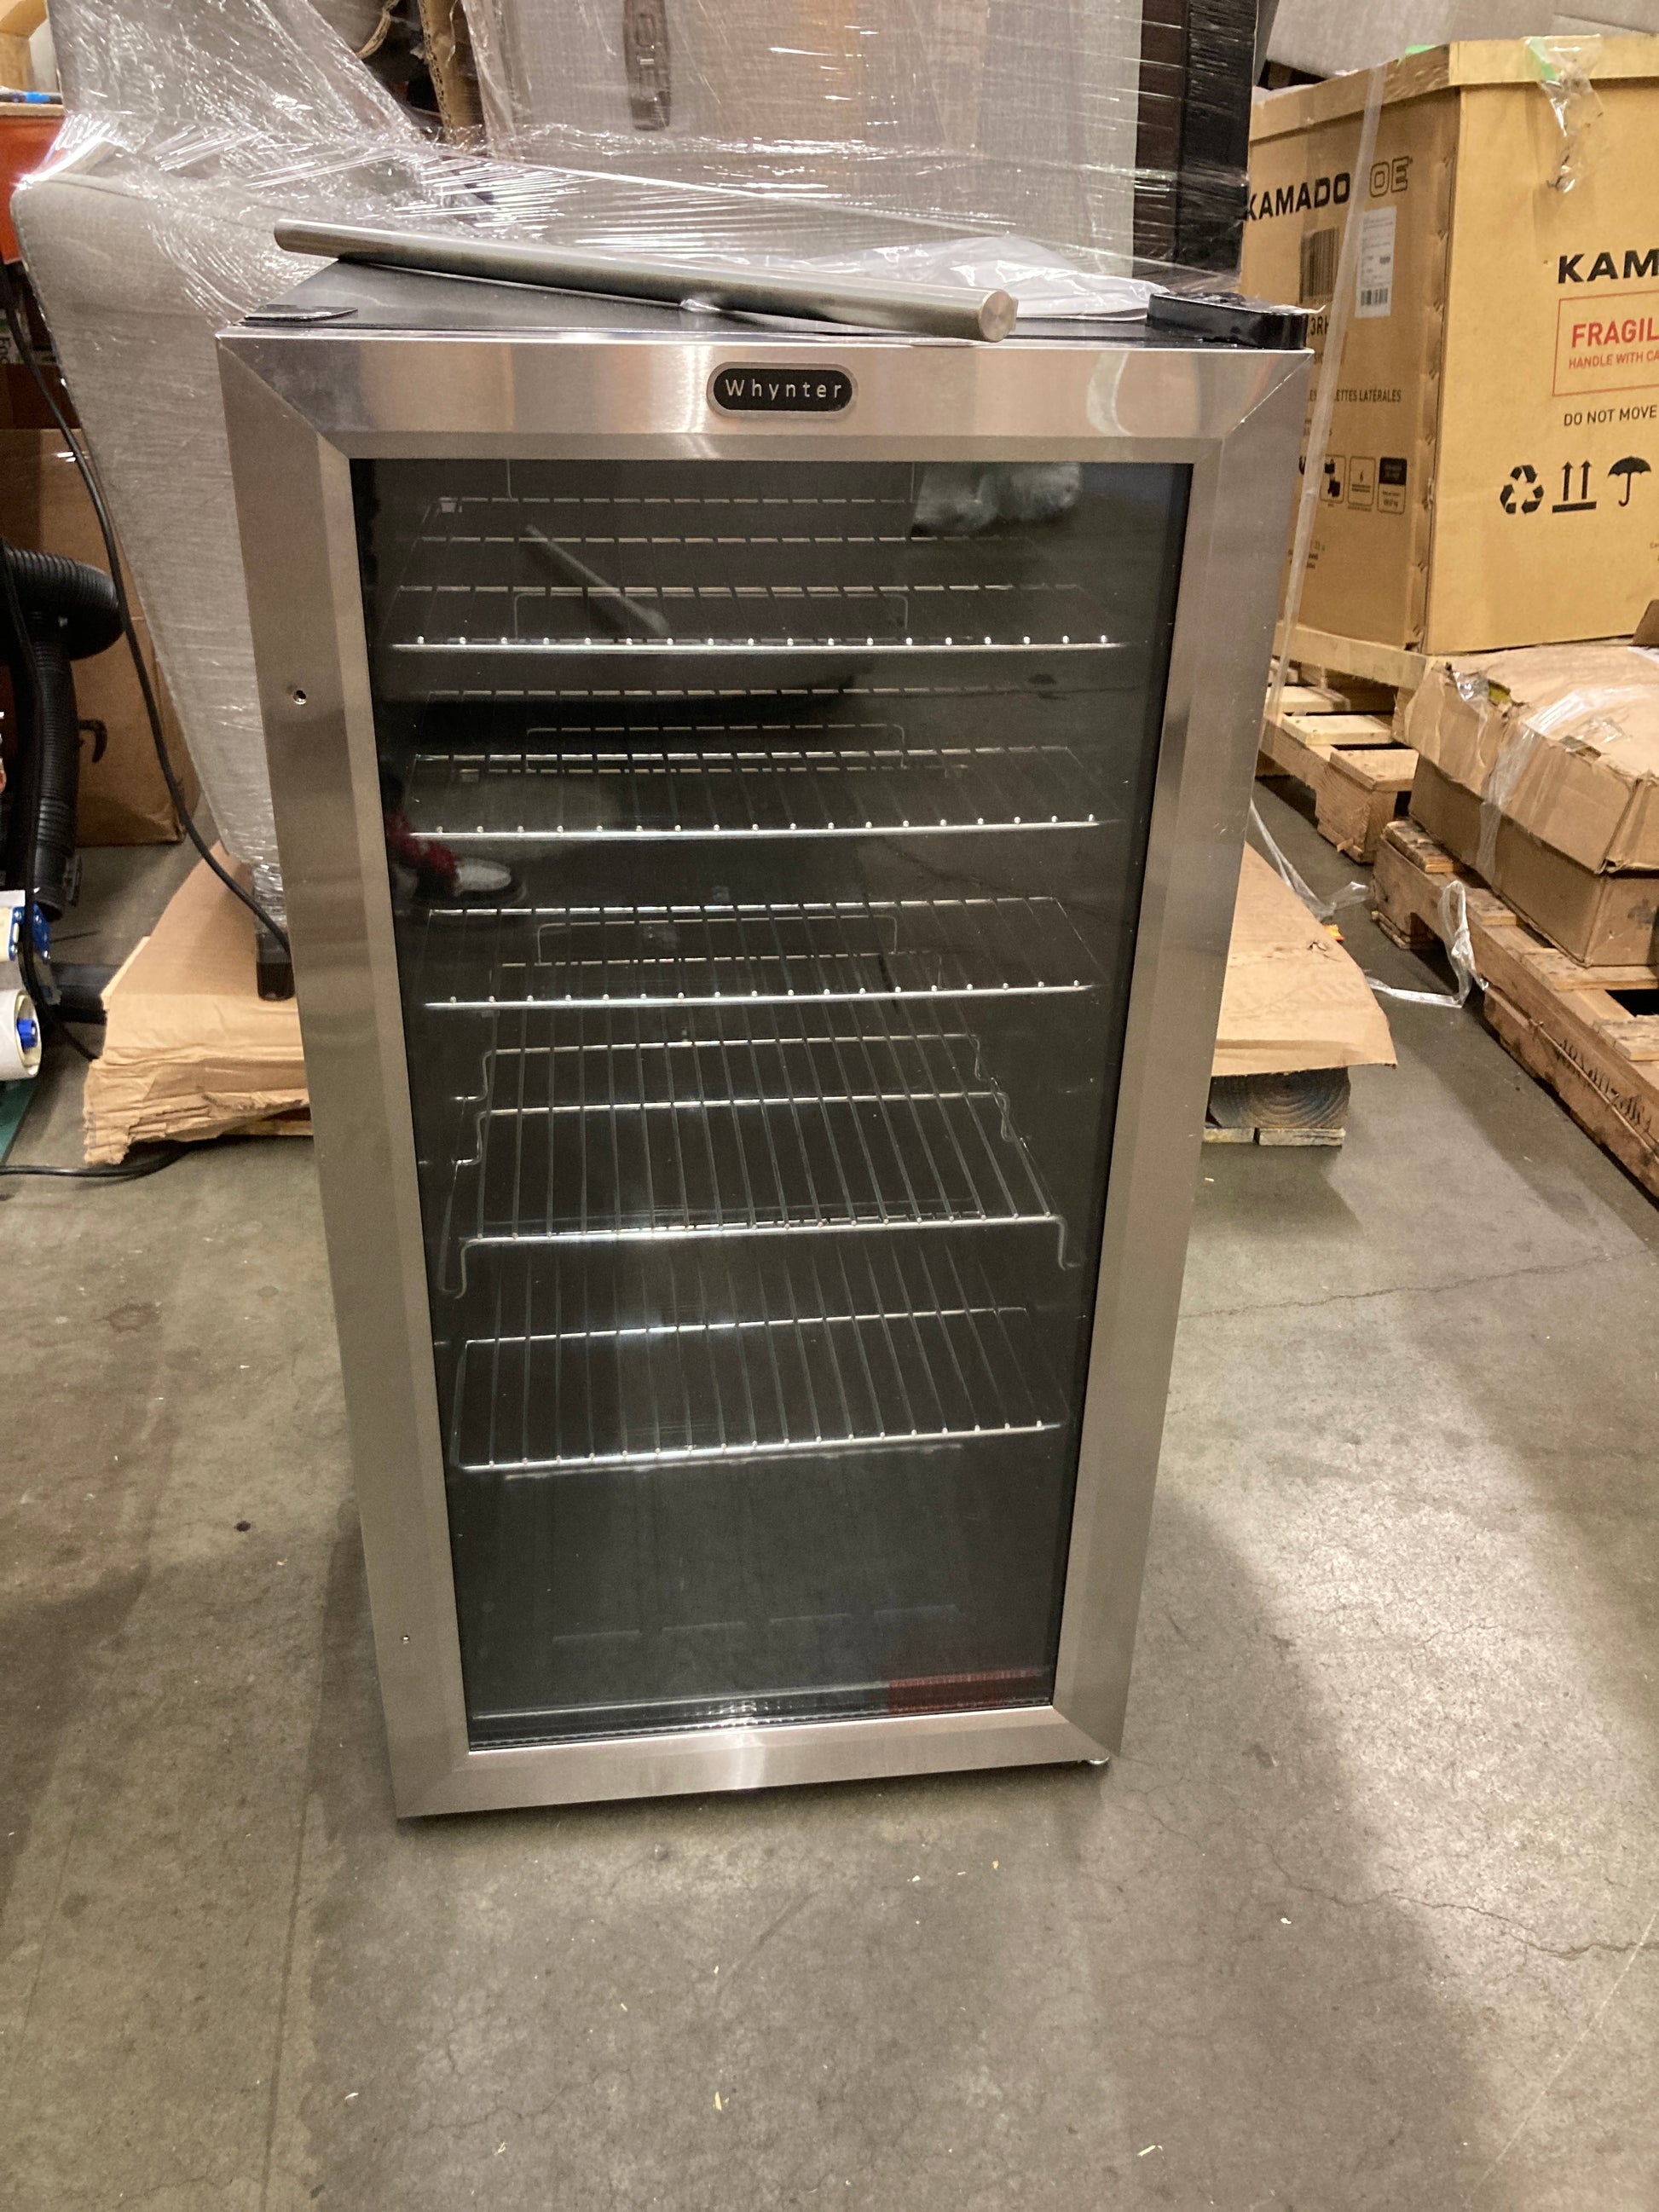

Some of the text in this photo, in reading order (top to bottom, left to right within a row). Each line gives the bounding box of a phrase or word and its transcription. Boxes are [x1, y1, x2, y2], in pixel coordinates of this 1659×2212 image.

[1369, 156, 1409, 198] OE
[1558, 249, 1659, 284] KAM
[1571, 317, 1659, 348] FRAGIL
[1569, 354, 1612, 369] HANDLE
[1616, 351, 1643, 364] WITH
[725, 378, 842, 401] Whynter
[1564, 404, 1657, 427] DO NOT MOVE
